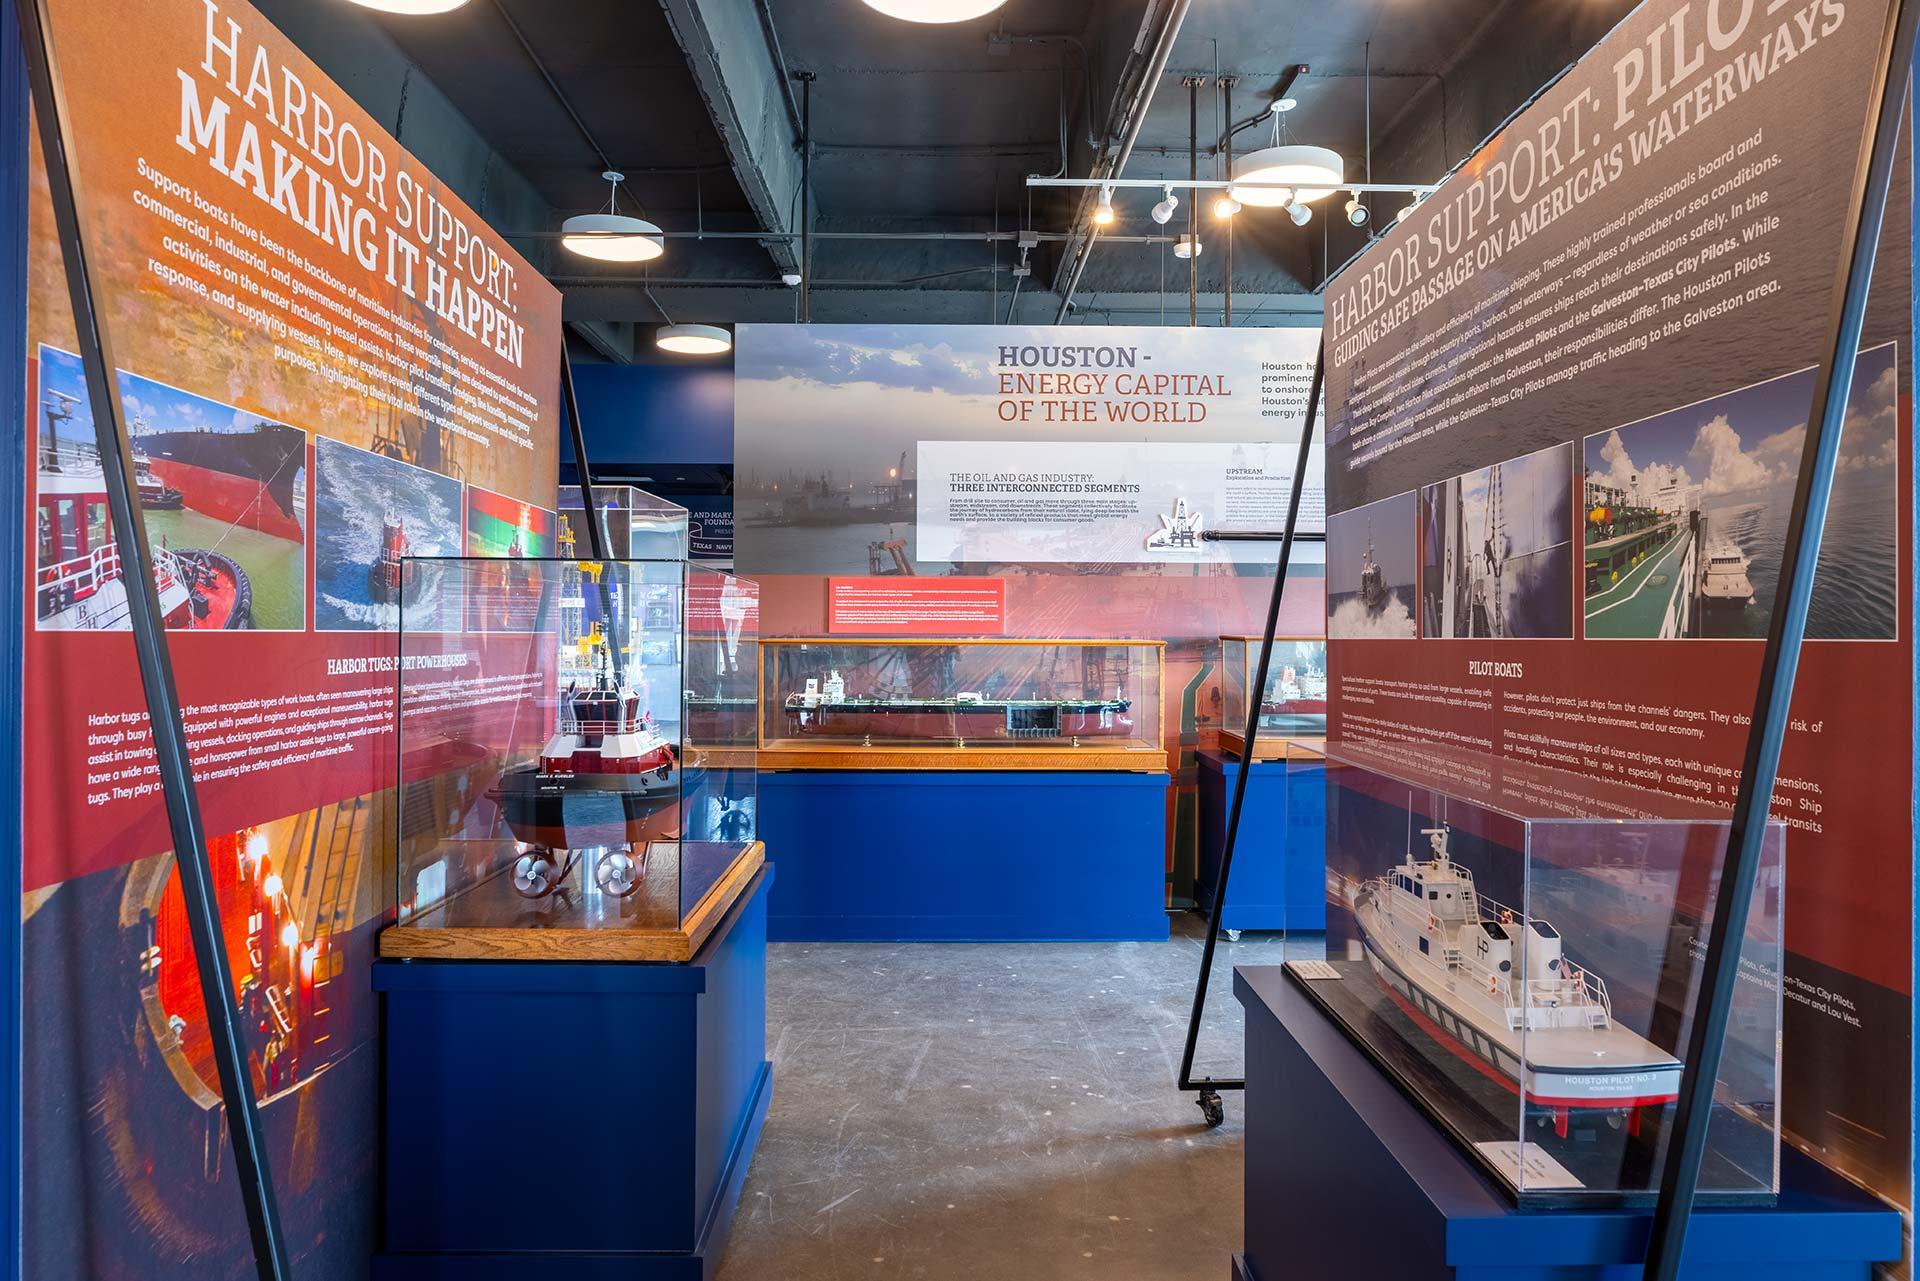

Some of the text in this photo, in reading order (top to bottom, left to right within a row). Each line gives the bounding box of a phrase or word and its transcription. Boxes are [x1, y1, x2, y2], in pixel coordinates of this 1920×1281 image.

[201, 0, 518, 314] HARBOR SUPPORT:
[1332, 0, 1788, 341] HARBOR SUPPORT: PILO
[1335, 0, 1845, 368] GUIDING SAFE PASSAGE ON AMERICA'S WATERWAYS
[1593, 127, 1763, 244] trained professionals board and
[1630, 152, 1783, 247] weather or sea conditions.
[137, 157, 357, 300] Support boats have been the backbone of
[176, 68, 524, 369] MAKING IT HAPPEN
[1624, 189, 1769, 275] destinations safely. In the
[133, 190, 352, 320] commercial, industrial, and governmental
[1676, 254, 1699, 276] City
[1701, 237, 1740, 264] Pilots.
[1742, 214, 1780, 244] While
[148, 258, 322, 351] response, and supplying vessels.
[163, 236, 358, 344] activities on the water including vessel
[1630, 251, 1771, 325] differ. The Houston Pilots
[1608, 278, 1782, 360] heading to the Galveston area.
[275, 345, 368, 397] purposes, highlighting
[998, 346, 1137, 368] HOUSTON
[1261, 362, 1302, 371] Houston
[998, 373, 1232, 396] ENERGY CAPITAL
[1261, 386, 1272, 394] to
[1261, 397, 1310, 406] Houston's
[998, 400, 1207, 423] OF THE WORLD
[1261, 410, 1296, 419] energy
[950, 473, 1095, 483] THE OIL AND GAS INDUSTRY:
[950, 484, 1140, 493] THREE INTERCONNECTED SEGMENTS
[327, 659, 368, 675] HARBOR
[368, 657, 393, 673] TUGS:
[416, 653, 467, 669] POWERHOUSES
[1469, 660, 1523, 678] PILOT BOATS
[88, 703, 218, 726] Harbor tugs the most
[88, 713, 262, 746] through busy Equipped with powerful
[1668, 724, 1705, 739] economy.
[1673, 707, 1707, 721] dangers.
[1709, 710, 1730, 726] They
[1732, 713, 1751, 725] also
[1790, 719, 1807, 732] risk
[1811, 721, 1824, 733] of
[88, 735, 225, 765] assist towing vessels,
[88, 747, 248, 785] have wide horsepower
[88, 760, 270, 805] tugs. They play ensuring safety
[1641, 752, 1823, 794] types, each with unique mensions,
[1666, 773, 1823, 816] challenging in Ship
[1784, 816, 1823, 833] transits
[1783, 986, 1863, 1028] Decatur and Lou Vest.
[1816, 986, 1832, 1001] City
[1565, 1076, 1608, 1085] HOUSTON
[1611, 1075, 1635, 1084] PILOT
